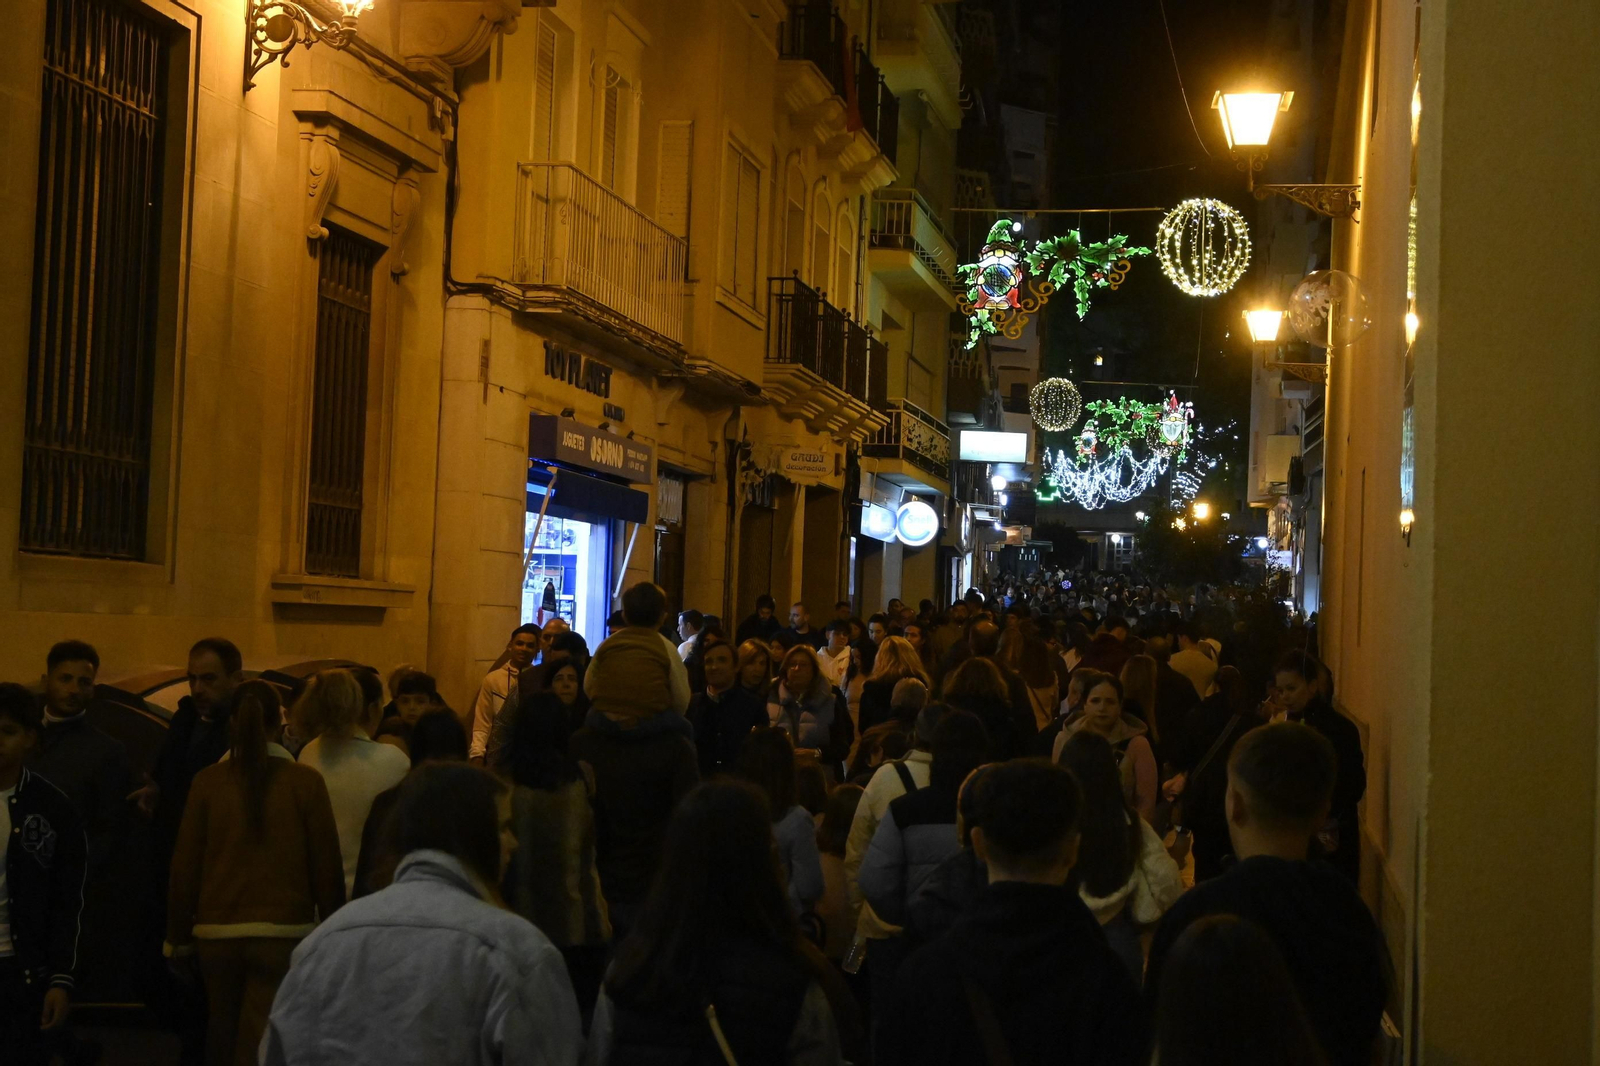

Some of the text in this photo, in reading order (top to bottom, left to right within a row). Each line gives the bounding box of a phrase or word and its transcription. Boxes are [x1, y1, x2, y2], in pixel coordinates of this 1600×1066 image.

[562, 431, 585, 451] JUGUETES
[590, 436, 624, 469] OSORNO
[786, 463, 827, 473] decoración
